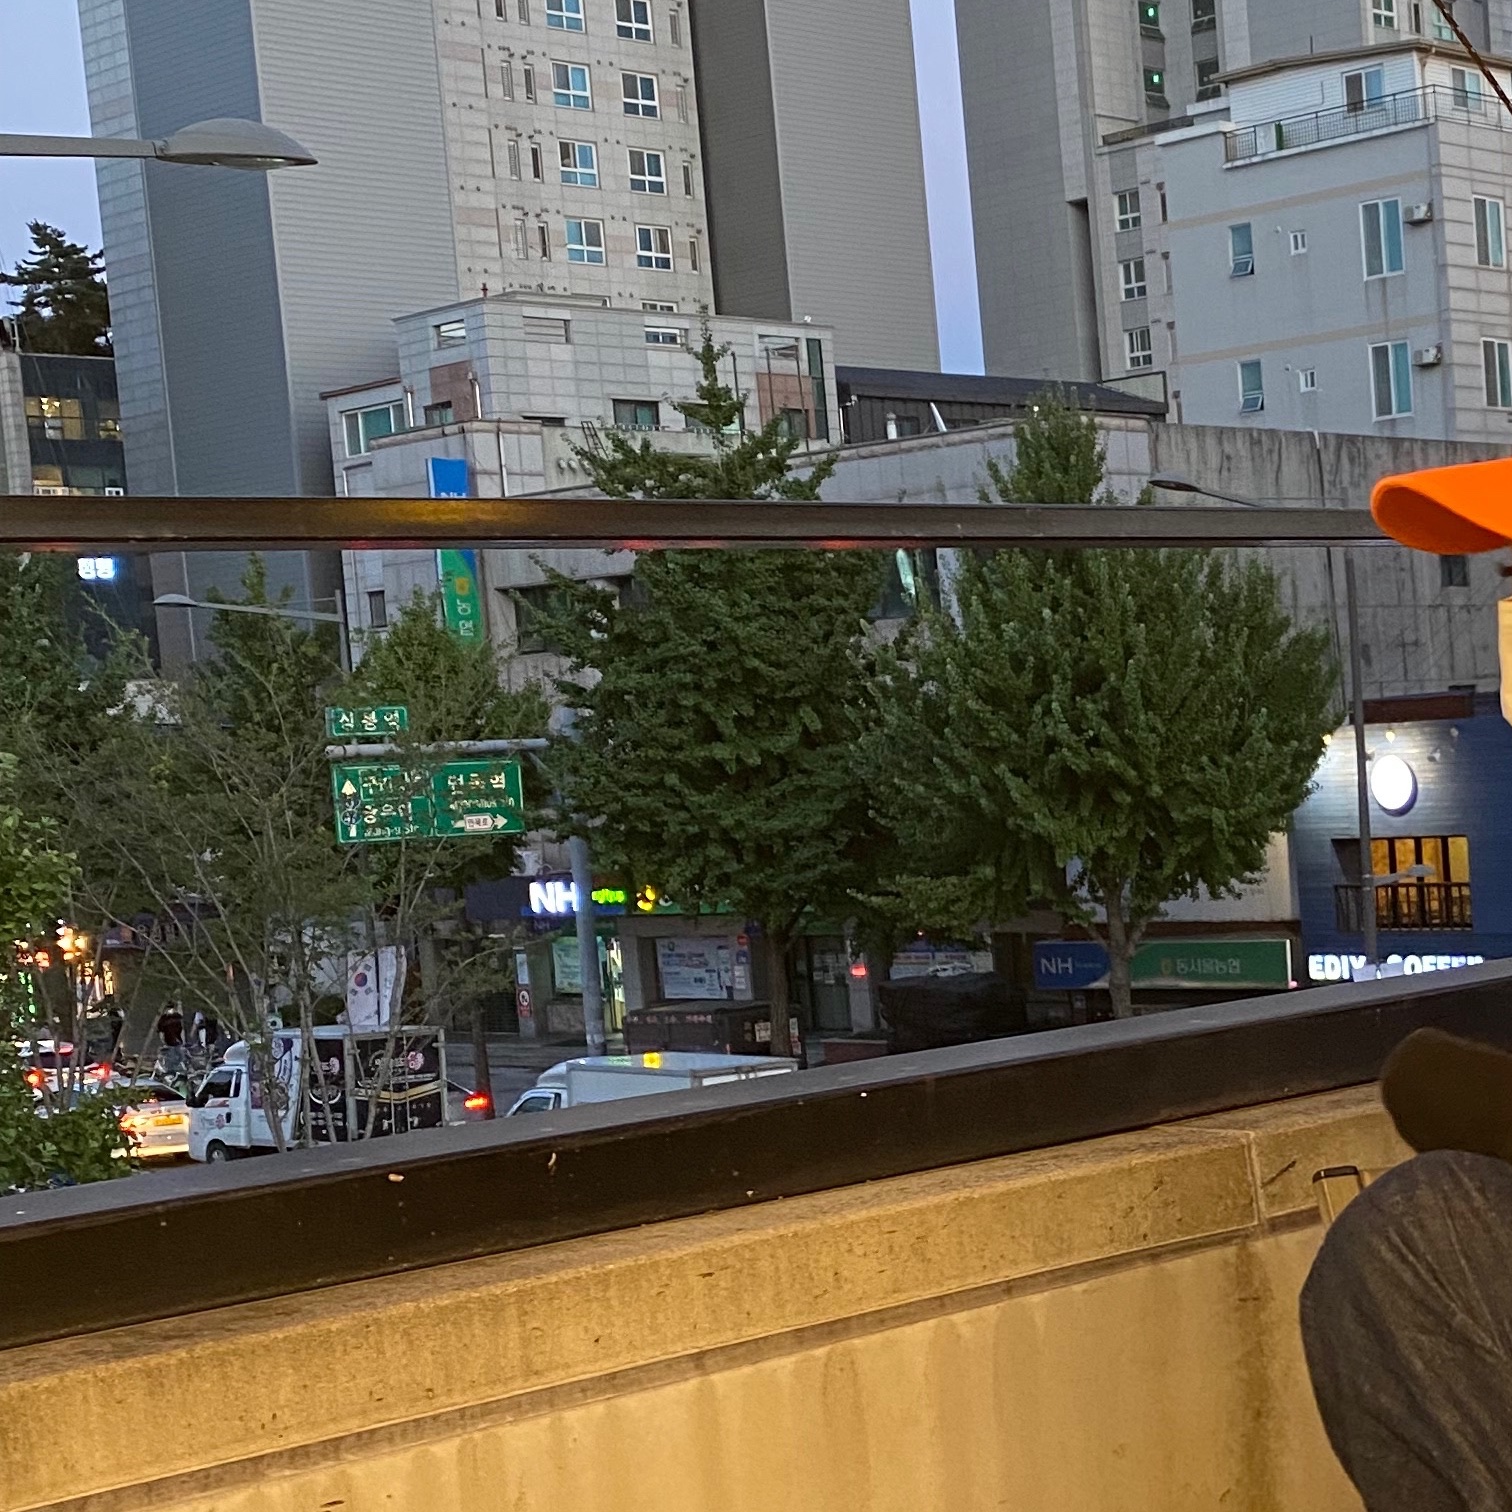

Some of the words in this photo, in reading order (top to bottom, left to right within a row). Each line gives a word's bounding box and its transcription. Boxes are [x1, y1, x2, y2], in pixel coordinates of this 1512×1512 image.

[456, 598, 475, 638] 농협
[529, 880, 579, 914] NH
[1040, 956, 1074, 975] NH
[1308, 954, 1384, 981] EDIY
